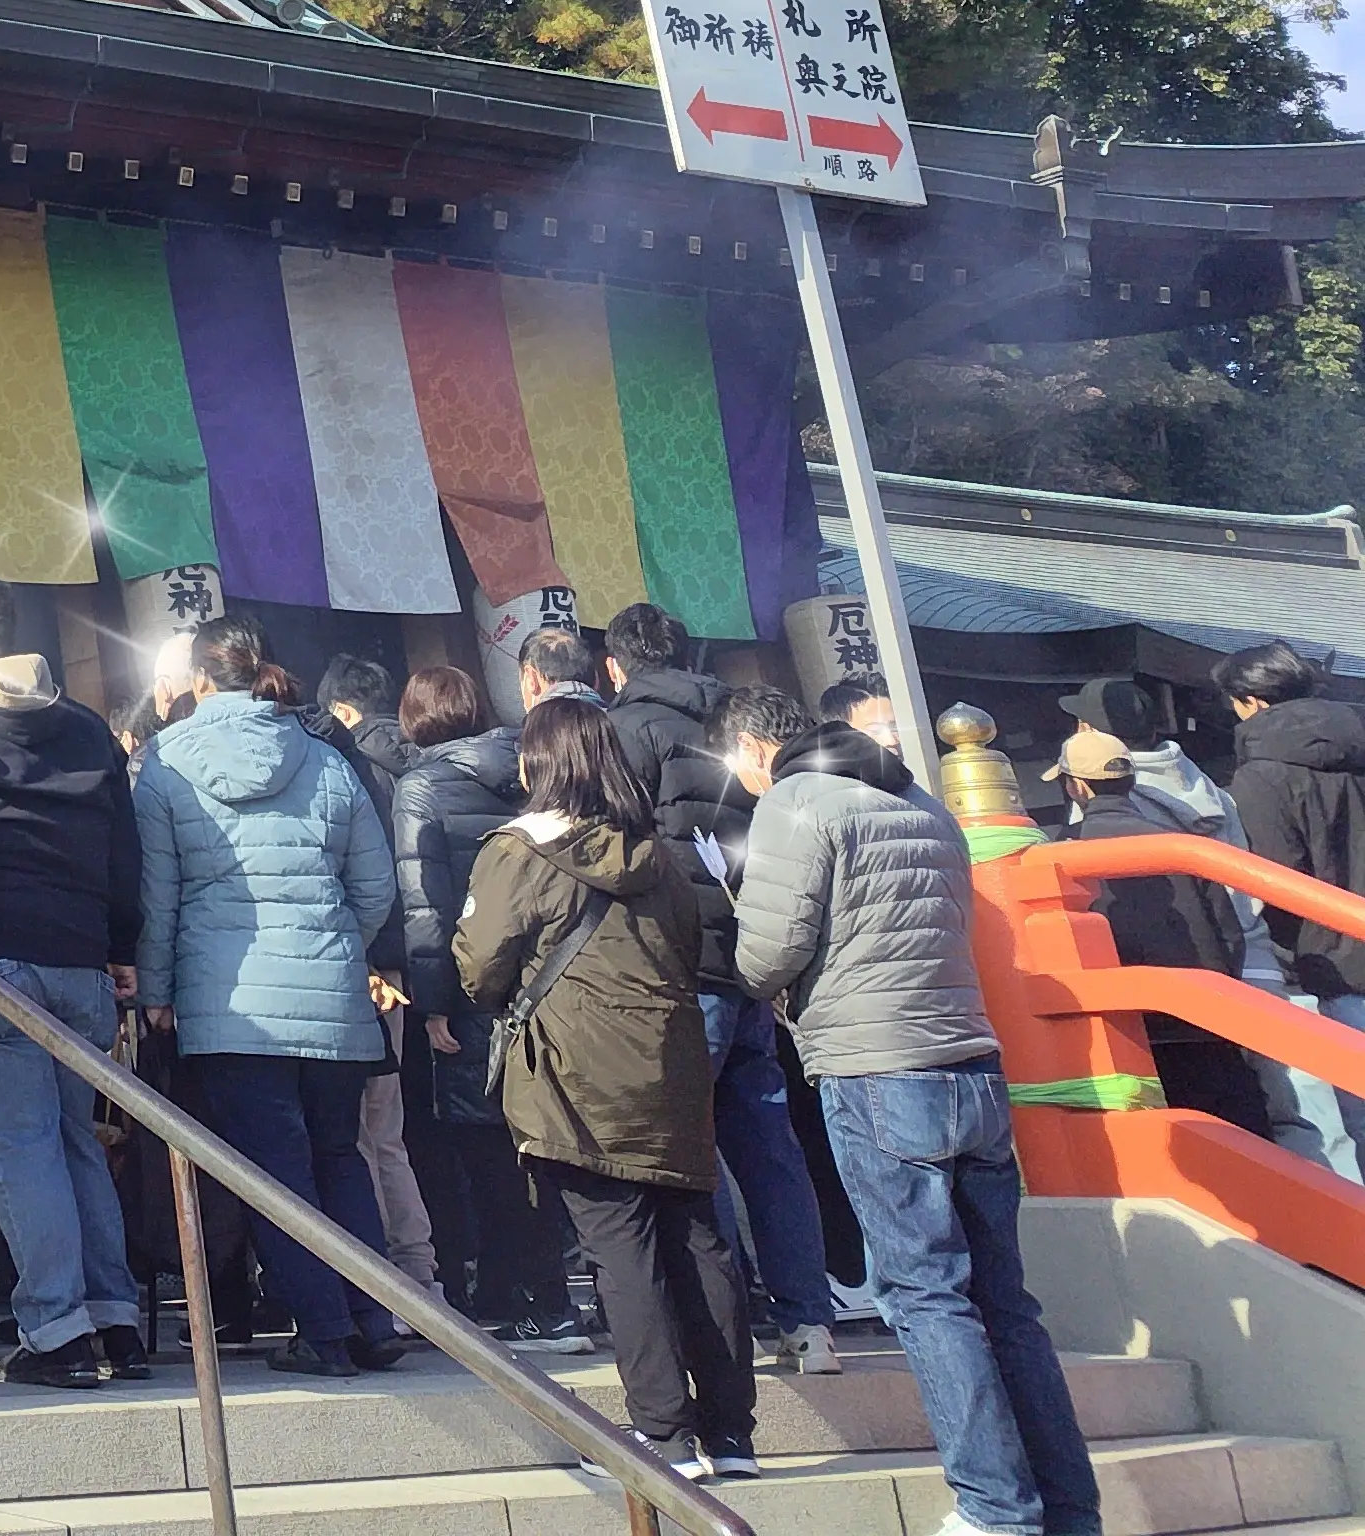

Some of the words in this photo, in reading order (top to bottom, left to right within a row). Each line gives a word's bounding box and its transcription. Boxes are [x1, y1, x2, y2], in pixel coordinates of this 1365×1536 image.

[663, 5, 775, 61] 御祈祷
[795, 52, 896, 105] 奥之院
